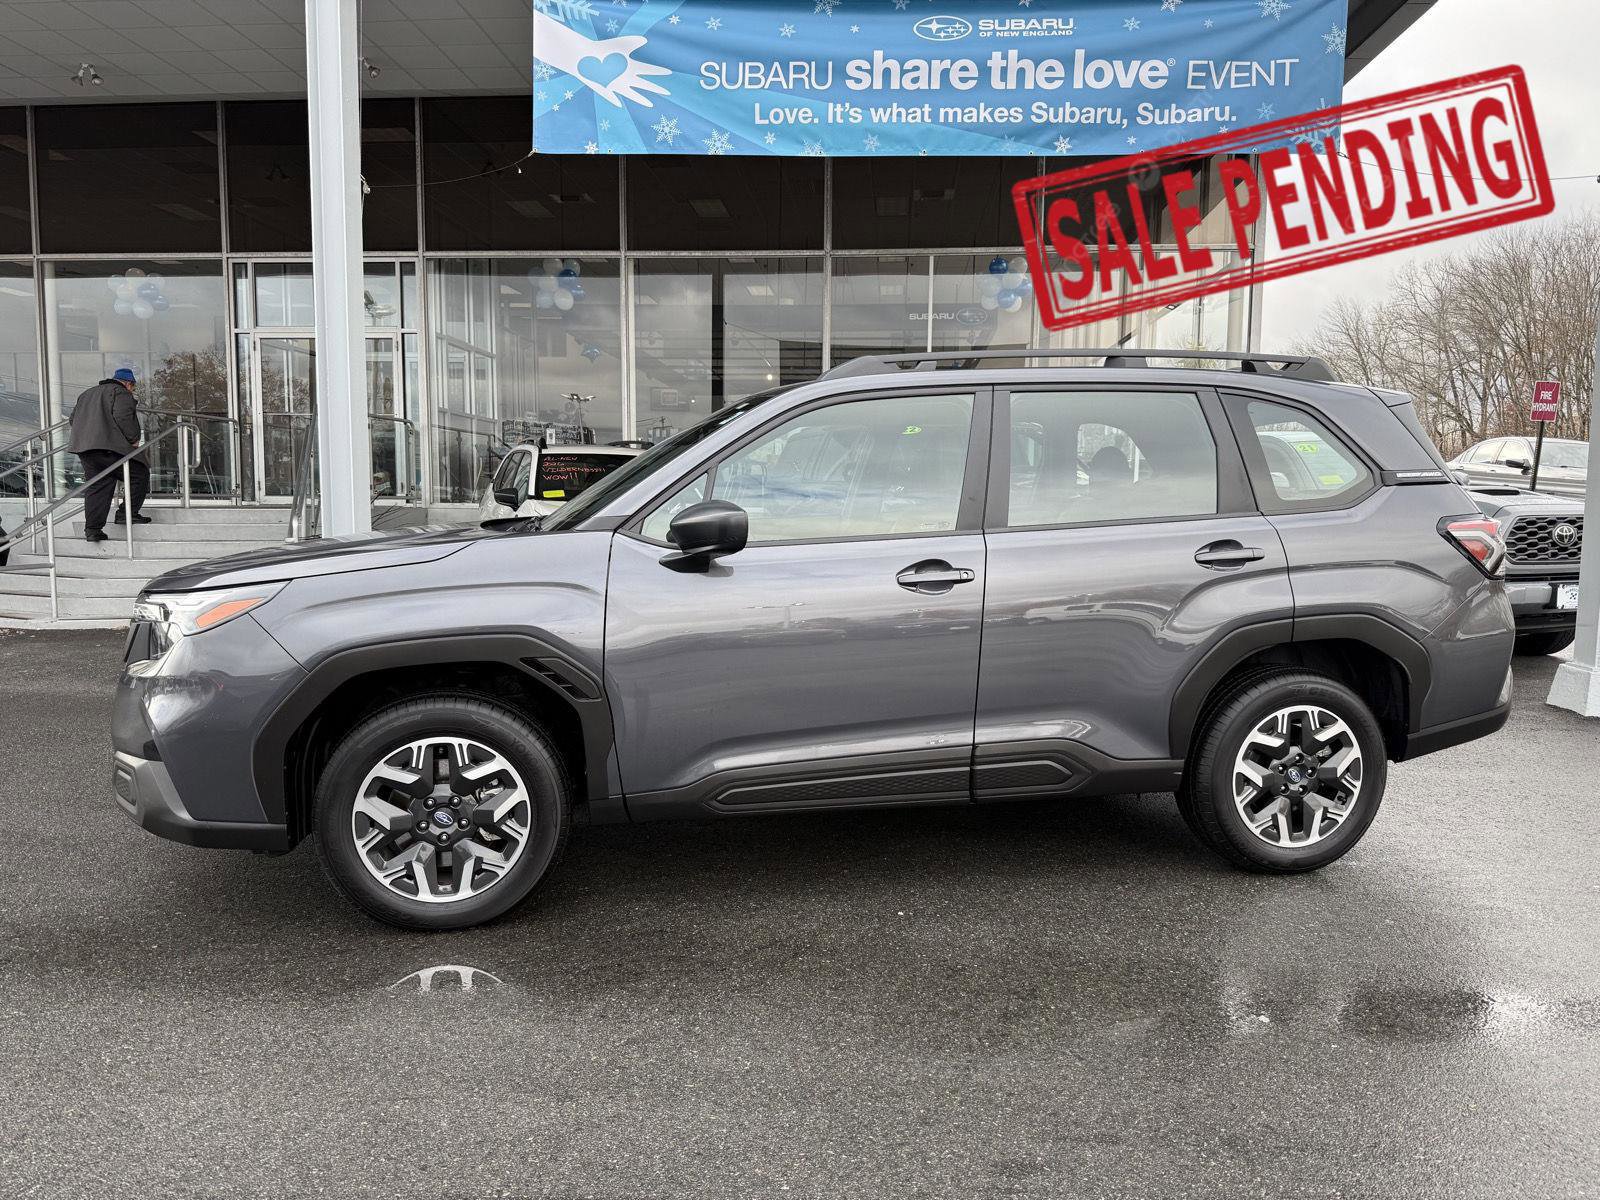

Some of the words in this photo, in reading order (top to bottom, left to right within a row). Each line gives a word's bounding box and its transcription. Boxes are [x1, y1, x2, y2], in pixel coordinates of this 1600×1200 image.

[978, 18, 1074, 30] SUBARU
[699, 61, 833, 91] SUBARU
[845, 49, 979, 91] share
[986, 50, 1067, 90] the
[1186, 58, 1300, 90] EVENT
[754, 102, 819, 125] Love.
[827, 102, 863, 125] It's
[869, 102, 932, 125] what
[938, 102, 1024, 124] makes
[1030, 101, 1129, 129] Subaru,
[1135, 102, 1237, 125] Subaru.
[1540, 390, 1553, 400] FIRE
[1532, 402, 1557, 412] HYDRANT
